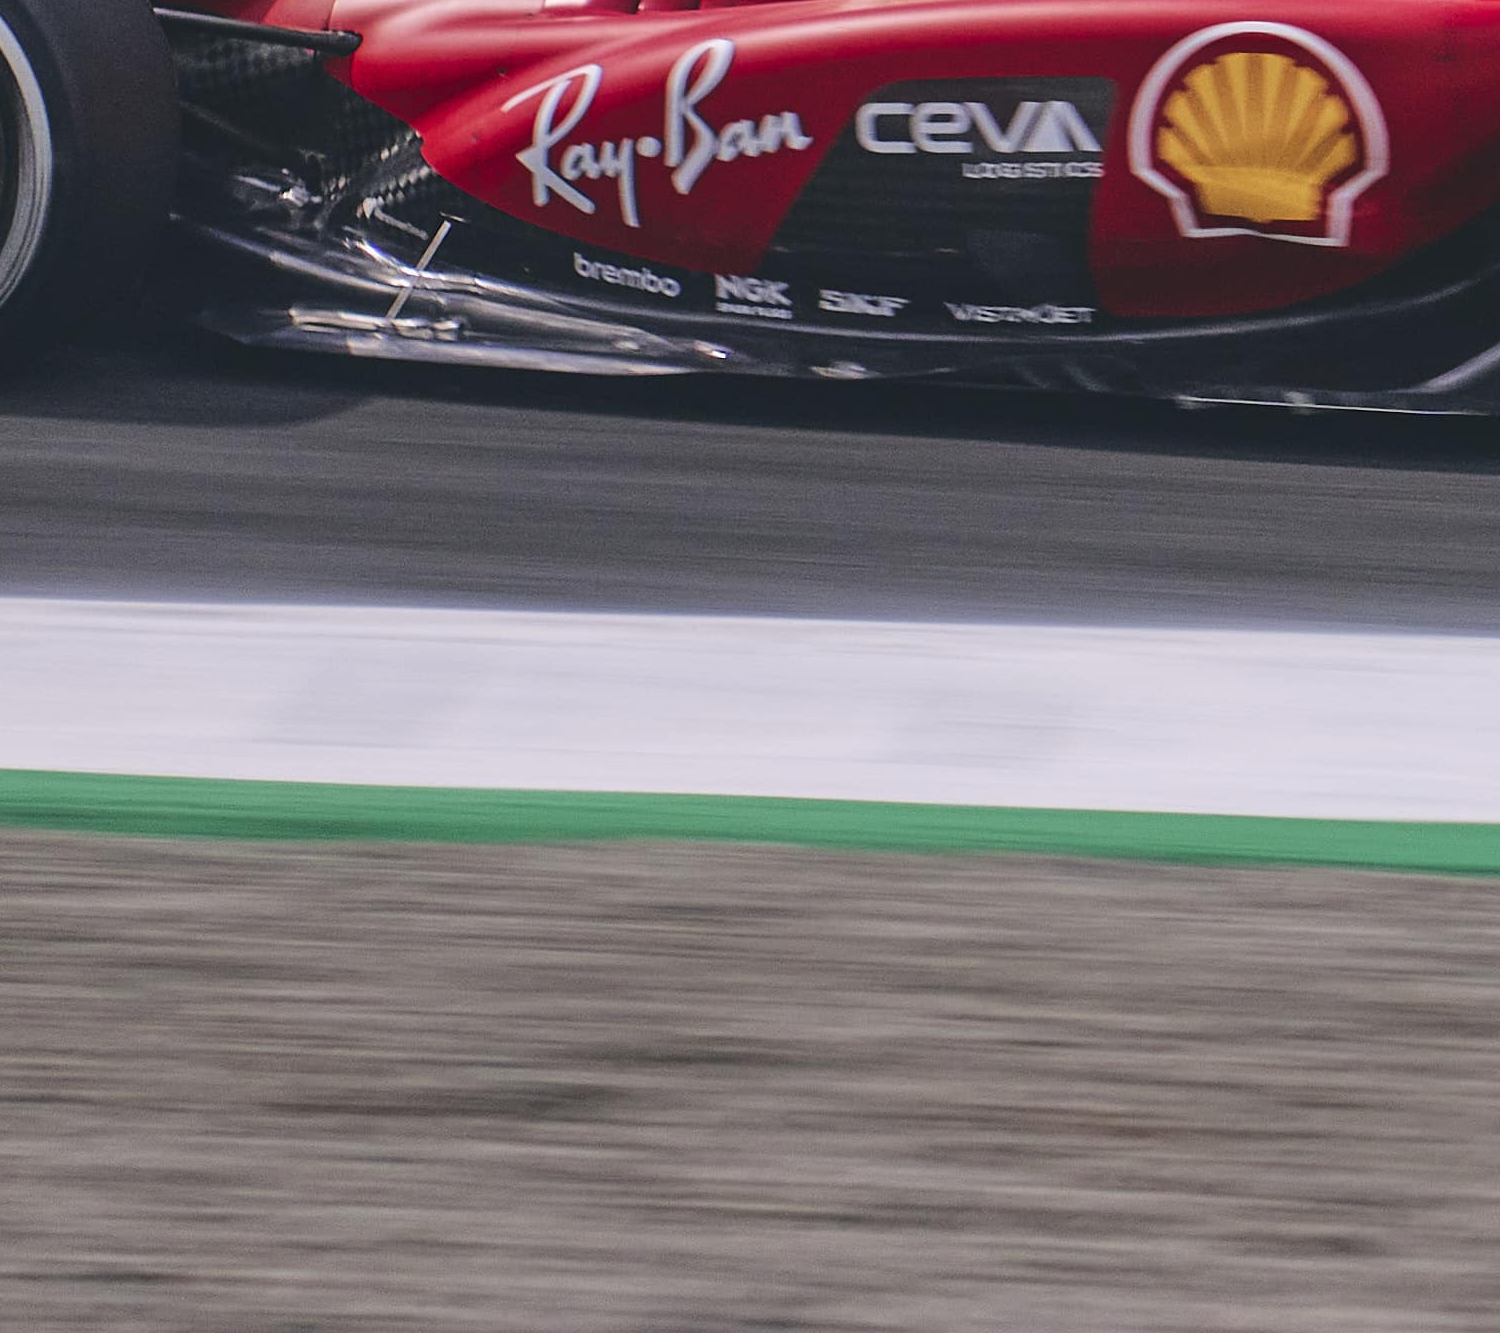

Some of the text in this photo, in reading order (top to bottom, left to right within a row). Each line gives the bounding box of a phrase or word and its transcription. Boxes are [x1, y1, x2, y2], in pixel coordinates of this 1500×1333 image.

[961, 161, 1106, 180] LOGISTICS
[573, 251, 682, 299] brembo
[714, 273, 795, 307] NGK
